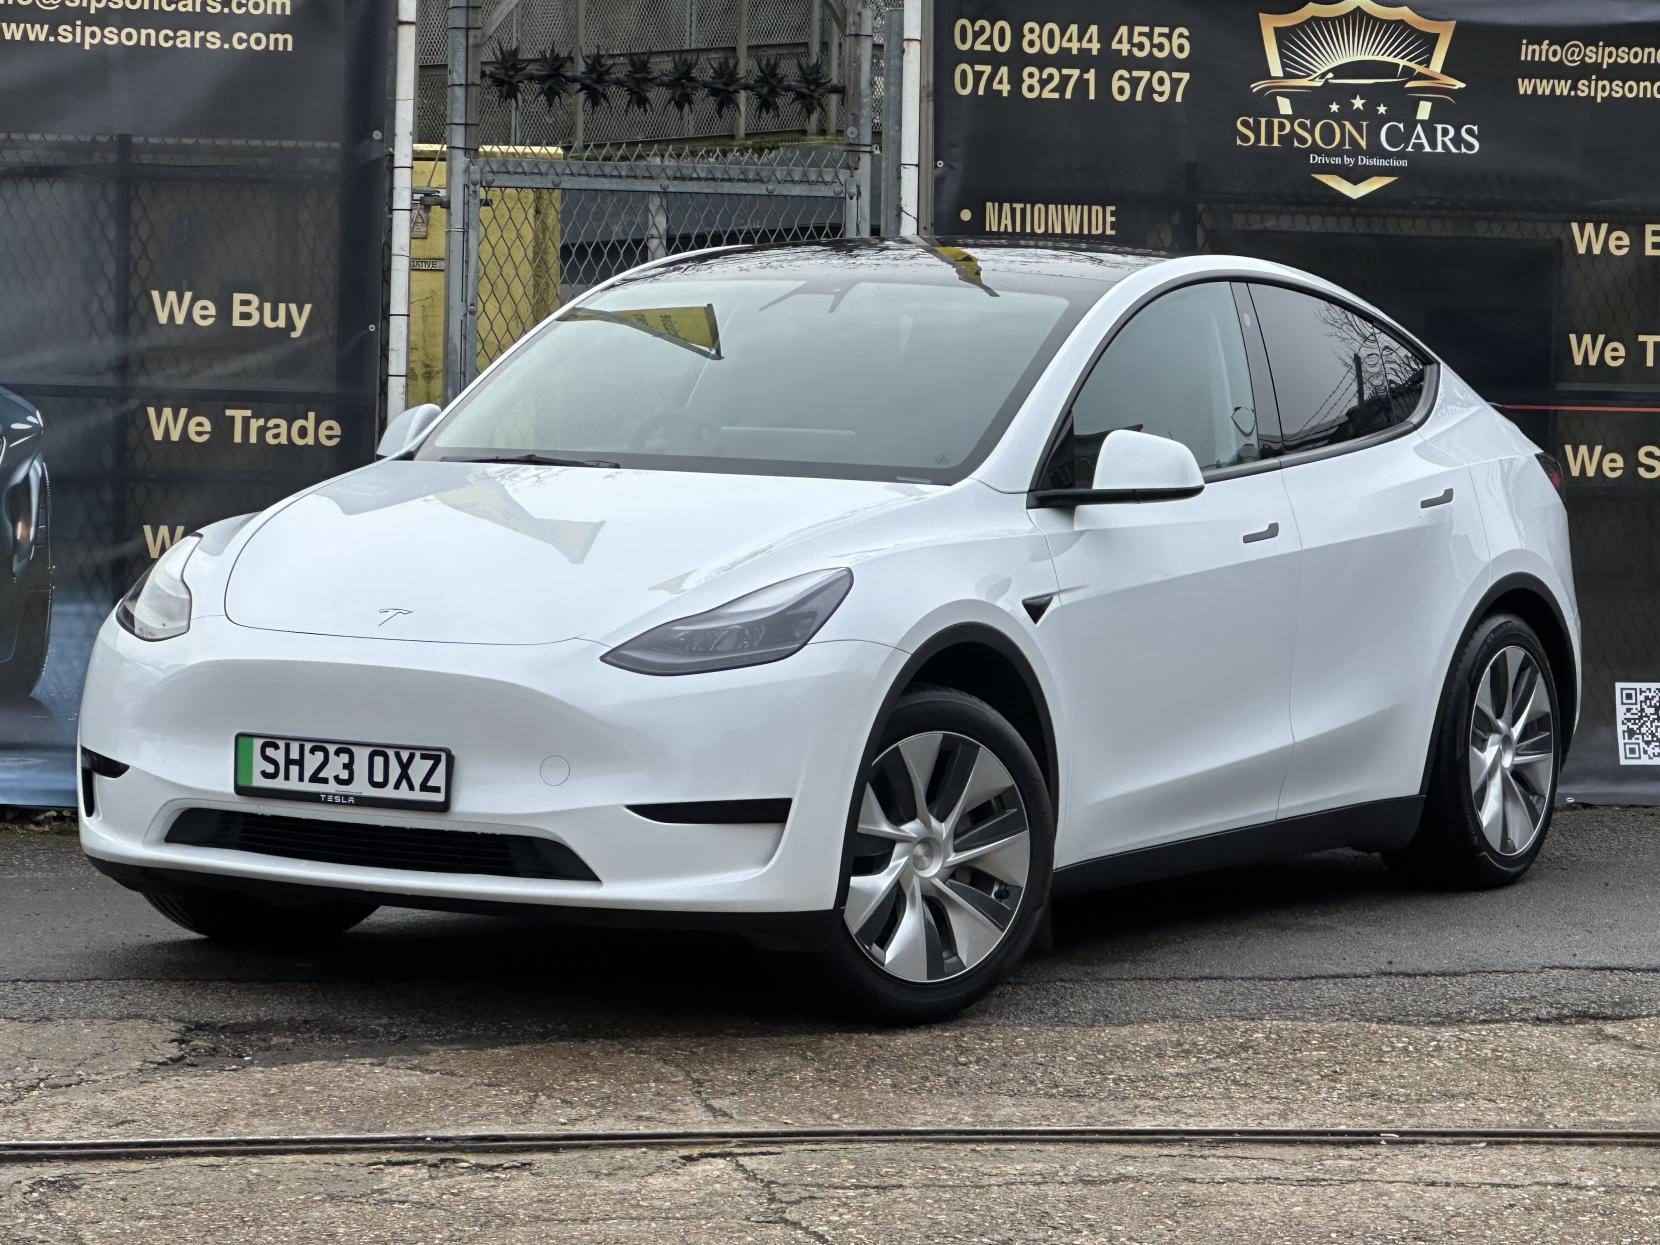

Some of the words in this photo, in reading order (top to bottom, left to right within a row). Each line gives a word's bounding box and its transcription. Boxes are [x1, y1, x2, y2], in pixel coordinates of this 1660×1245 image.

[0, 20, 293, 51] ww.sipsoncars.com
[954, 18, 1012, 52] 020
[1022, 21, 1101, 55] 8044
[1111, 25, 1191, 59] 4556
[1520, 39, 1660, 69] info@sipson
[954, 63, 1011, 96] 074
[1021, 66, 1096, 99] 8271
[1111, 70, 1191, 102] 6797
[1236, 117, 1370, 150] SIPSON
[1379, 121, 1480, 154] CARS
[1309, 153, 1342, 165] Driven
[1343, 154, 1356, 167] by
[1357, 155, 1408, 167] Distinction
[985, 202, 1116, 235] NATIONWIDE
[1571, 222, 1631, 256] We
[150, 290, 217, 327] We
[231, 292, 312, 338] Buy
[1569, 333, 1626, 367] We
[146, 406, 212, 443] We
[225, 409, 342, 447] Trade
[1565, 444, 1624, 478] We
[143, 524, 185, 559] W
[259, 740, 355, 786] SH23
[320, 794, 355, 804] TESLA
